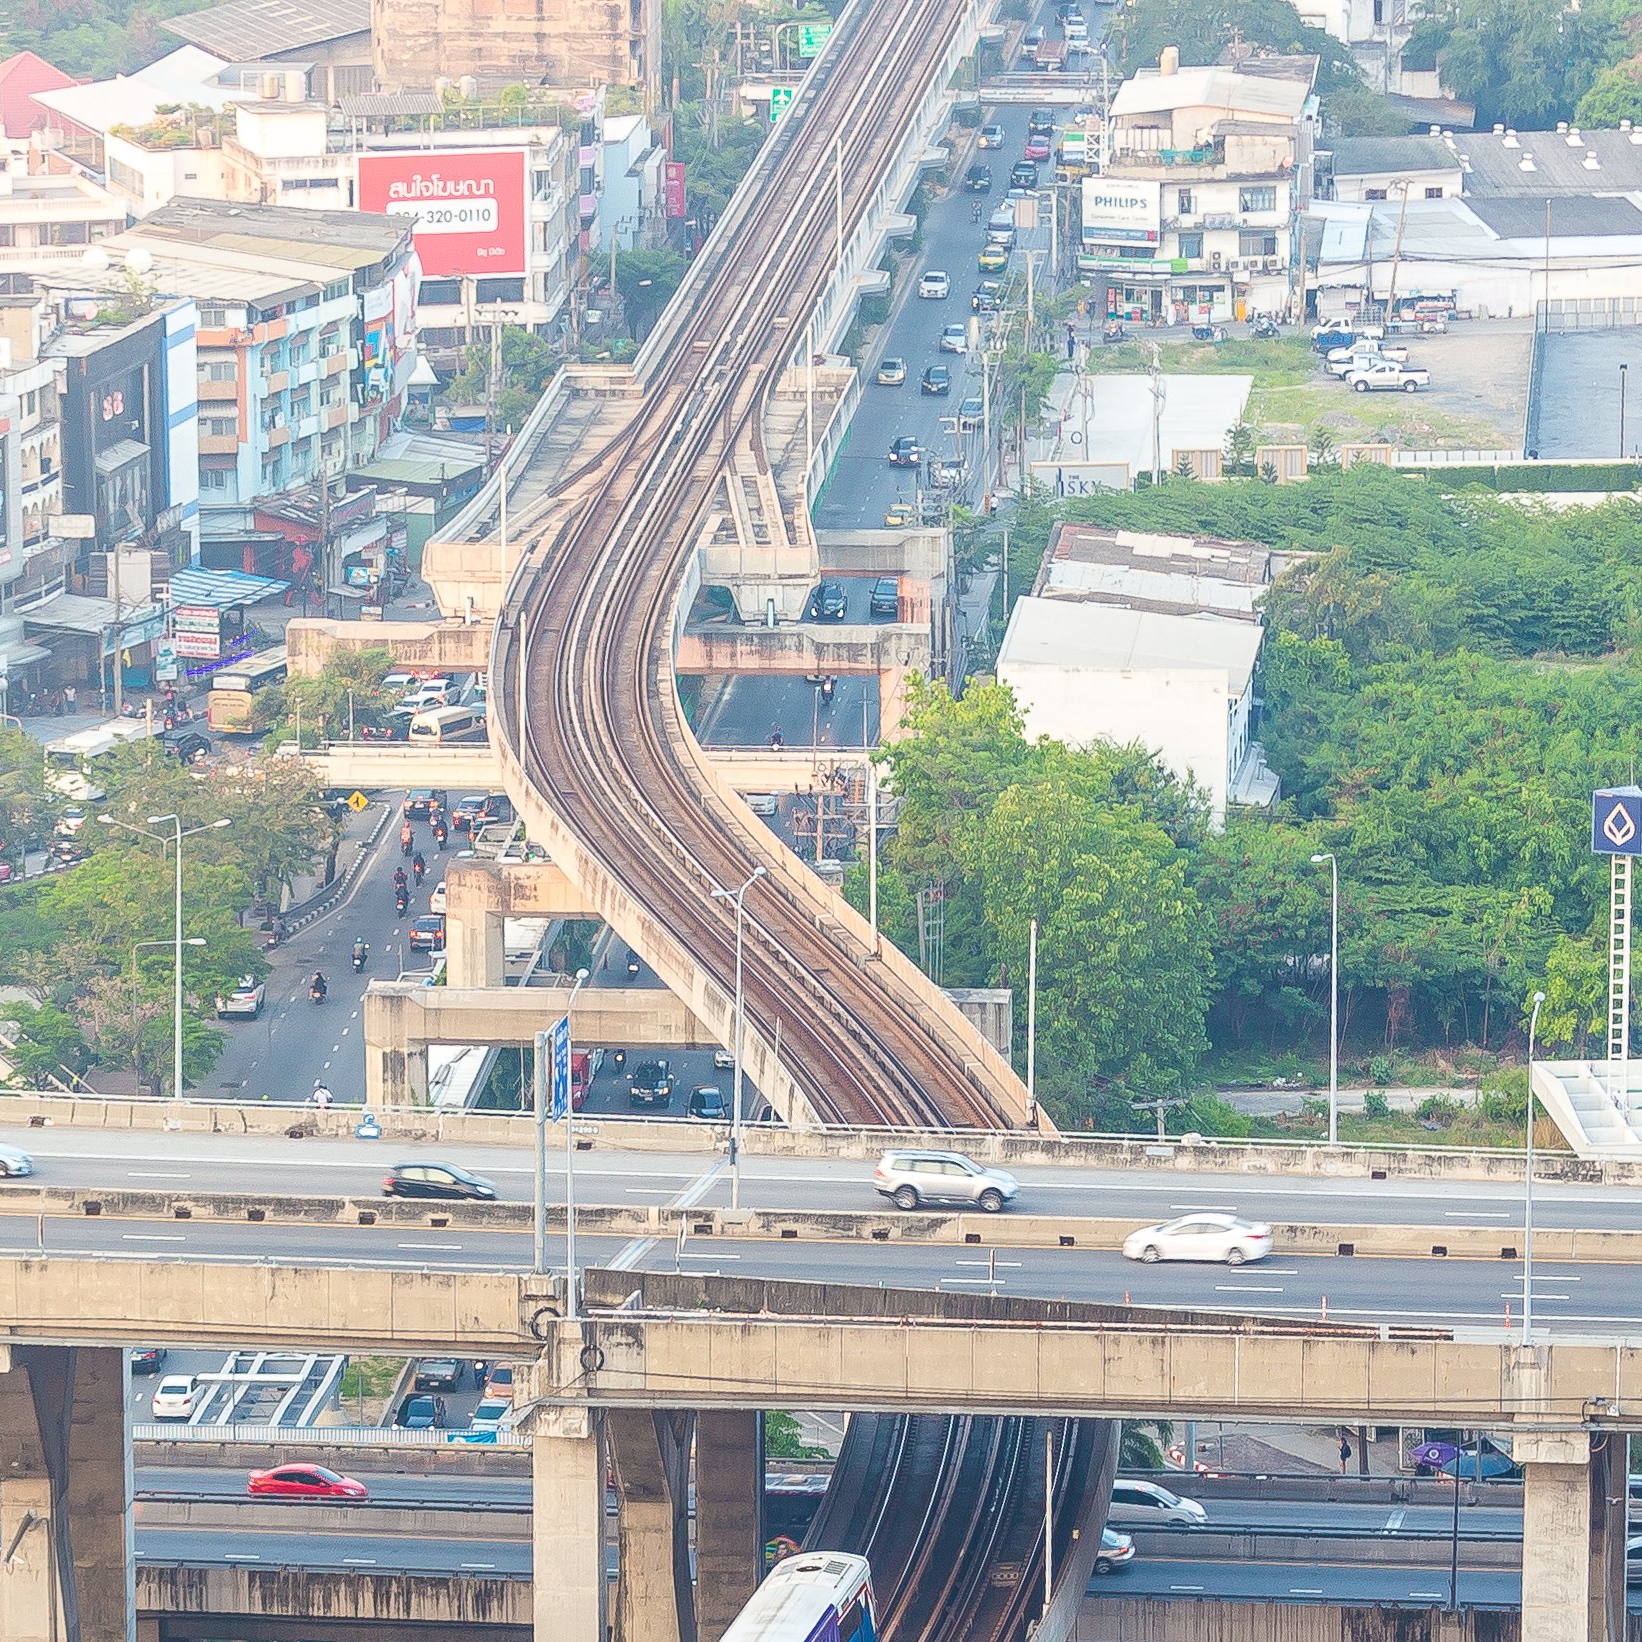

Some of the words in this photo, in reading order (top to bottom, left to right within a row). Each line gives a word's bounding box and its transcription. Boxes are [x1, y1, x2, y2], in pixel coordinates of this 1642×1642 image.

[389, 174, 495, 198] สนใจโฆษณา
[1094, 196, 1147, 209] PHILIPS
[1068, 480, 1102, 494] SKY
